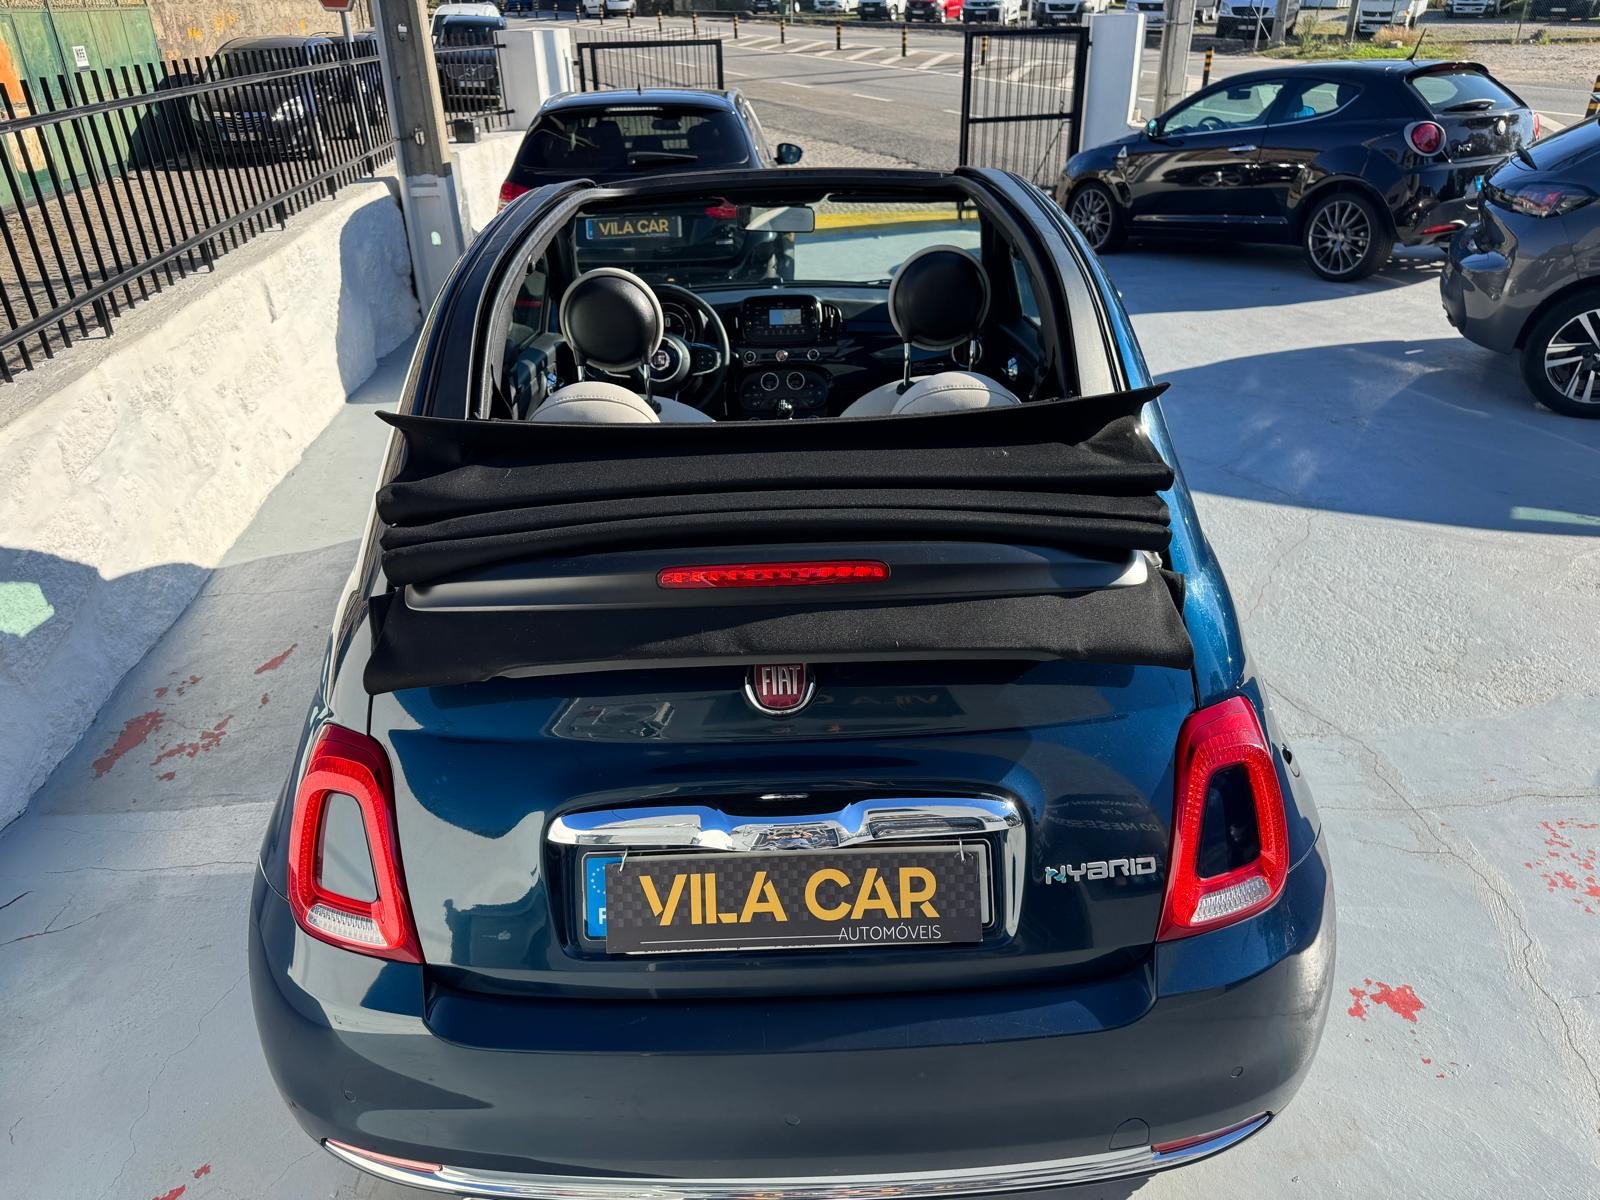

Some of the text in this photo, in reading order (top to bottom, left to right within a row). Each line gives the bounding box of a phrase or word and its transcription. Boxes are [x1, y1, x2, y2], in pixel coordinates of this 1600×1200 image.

[598, 219, 669, 236] VILA CAR
[761, 664, 801, 696] FIAT
[1044, 856, 1157, 885] HYBRID
[638, 866, 941, 927] VILA CAR
[838, 921, 942, 941] AUTOMÓVEIS
